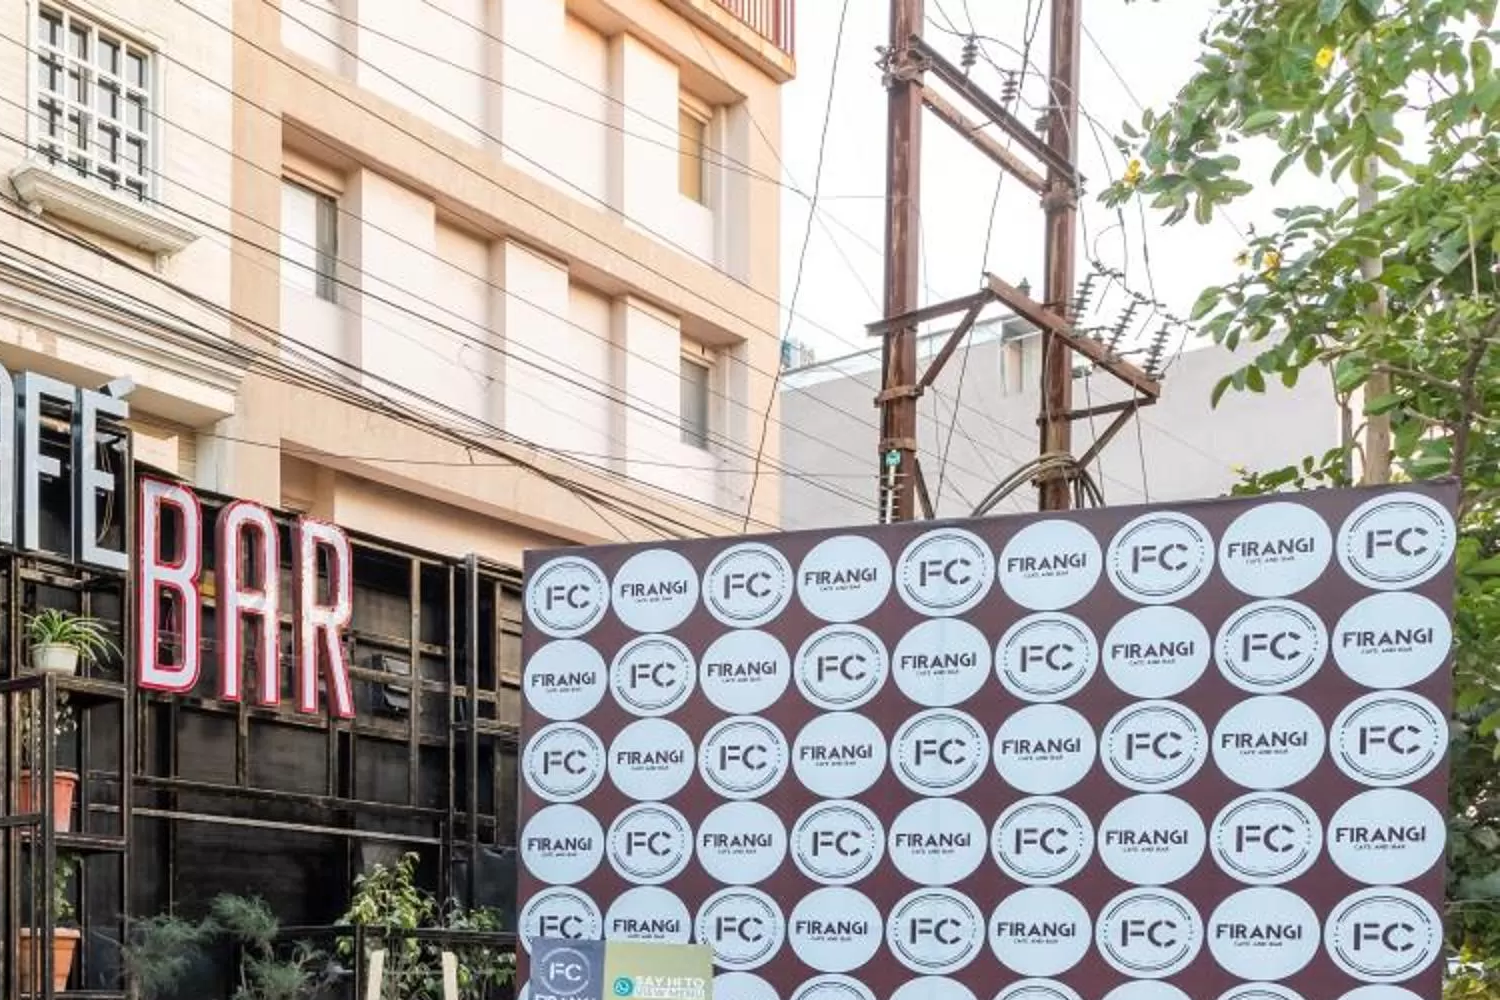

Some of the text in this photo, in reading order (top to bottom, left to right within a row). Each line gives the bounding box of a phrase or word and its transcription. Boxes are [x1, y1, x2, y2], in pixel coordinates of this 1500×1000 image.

[1227, 536, 1314, 558] FIRANGI
[1365, 525, 1427, 559] FC
[1007, 552, 1086, 572] FIRANGI
[1131, 541, 1188, 574] FC
[723, 570, 771, 600] FC
[804, 566, 877, 586] FIRANGI
[919, 557, 971, 588] FC
[137, 475, 357, 721] BAR
[546, 583, 589, 611] FC
[620, 579, 687, 598] FIRANGI
[1111, 640, 1194, 659] FIRANGI
[1241, 630, 1301, 662] FC
[1342, 627, 1433, 647] FIRANGI
[707, 660, 776, 677] FIRANGI
[816, 653, 866, 682] FC
[900, 651, 976, 670] FIRANGI
[1019, 642, 1073, 673] FC
[531, 671, 595, 687] FIRANGI
[630, 661, 675, 689] FC
[799, 743, 872, 760] FIRANGI
[914, 737, 965, 766] FC
[1001, 737, 1080, 754] FIRANGI
[1125, 730, 1182, 761] FC
[1221, 730, 1307, 748] FIRANGI
[1358, 724, 1420, 755] FC
[543, 749, 586, 775] FC
[617, 749, 683, 765] FIRANGI
[719, 743, 767, 771] FC
[527, 837, 591, 851] FIRANGI
[626, 830, 671, 856] FC
[702, 832, 772, 847] FIRANGI
[811, 829, 861, 857] FC
[895, 832, 970, 847] FIRANGI
[1014, 827, 1068, 855] FC
[1105, 829, 1188, 845] FIRANGI
[1235, 823, 1294, 853] FC
[1335, 825, 1426, 842] FIRANGI
[539, 914, 582, 939] FC
[613, 918, 679, 932] FIRANGI
[715, 916, 762, 942] FC
[795, 920, 867, 935] FIRANGI
[909, 917, 961, 945] FC
[997, 921, 1075, 937] FIRANGI
[1120, 919, 1176, 948] FC
[1215, 923, 1302, 939] FIRANGI
[1352, 922, 1414, 952] FC
[549, 961, 582, 982] FC
